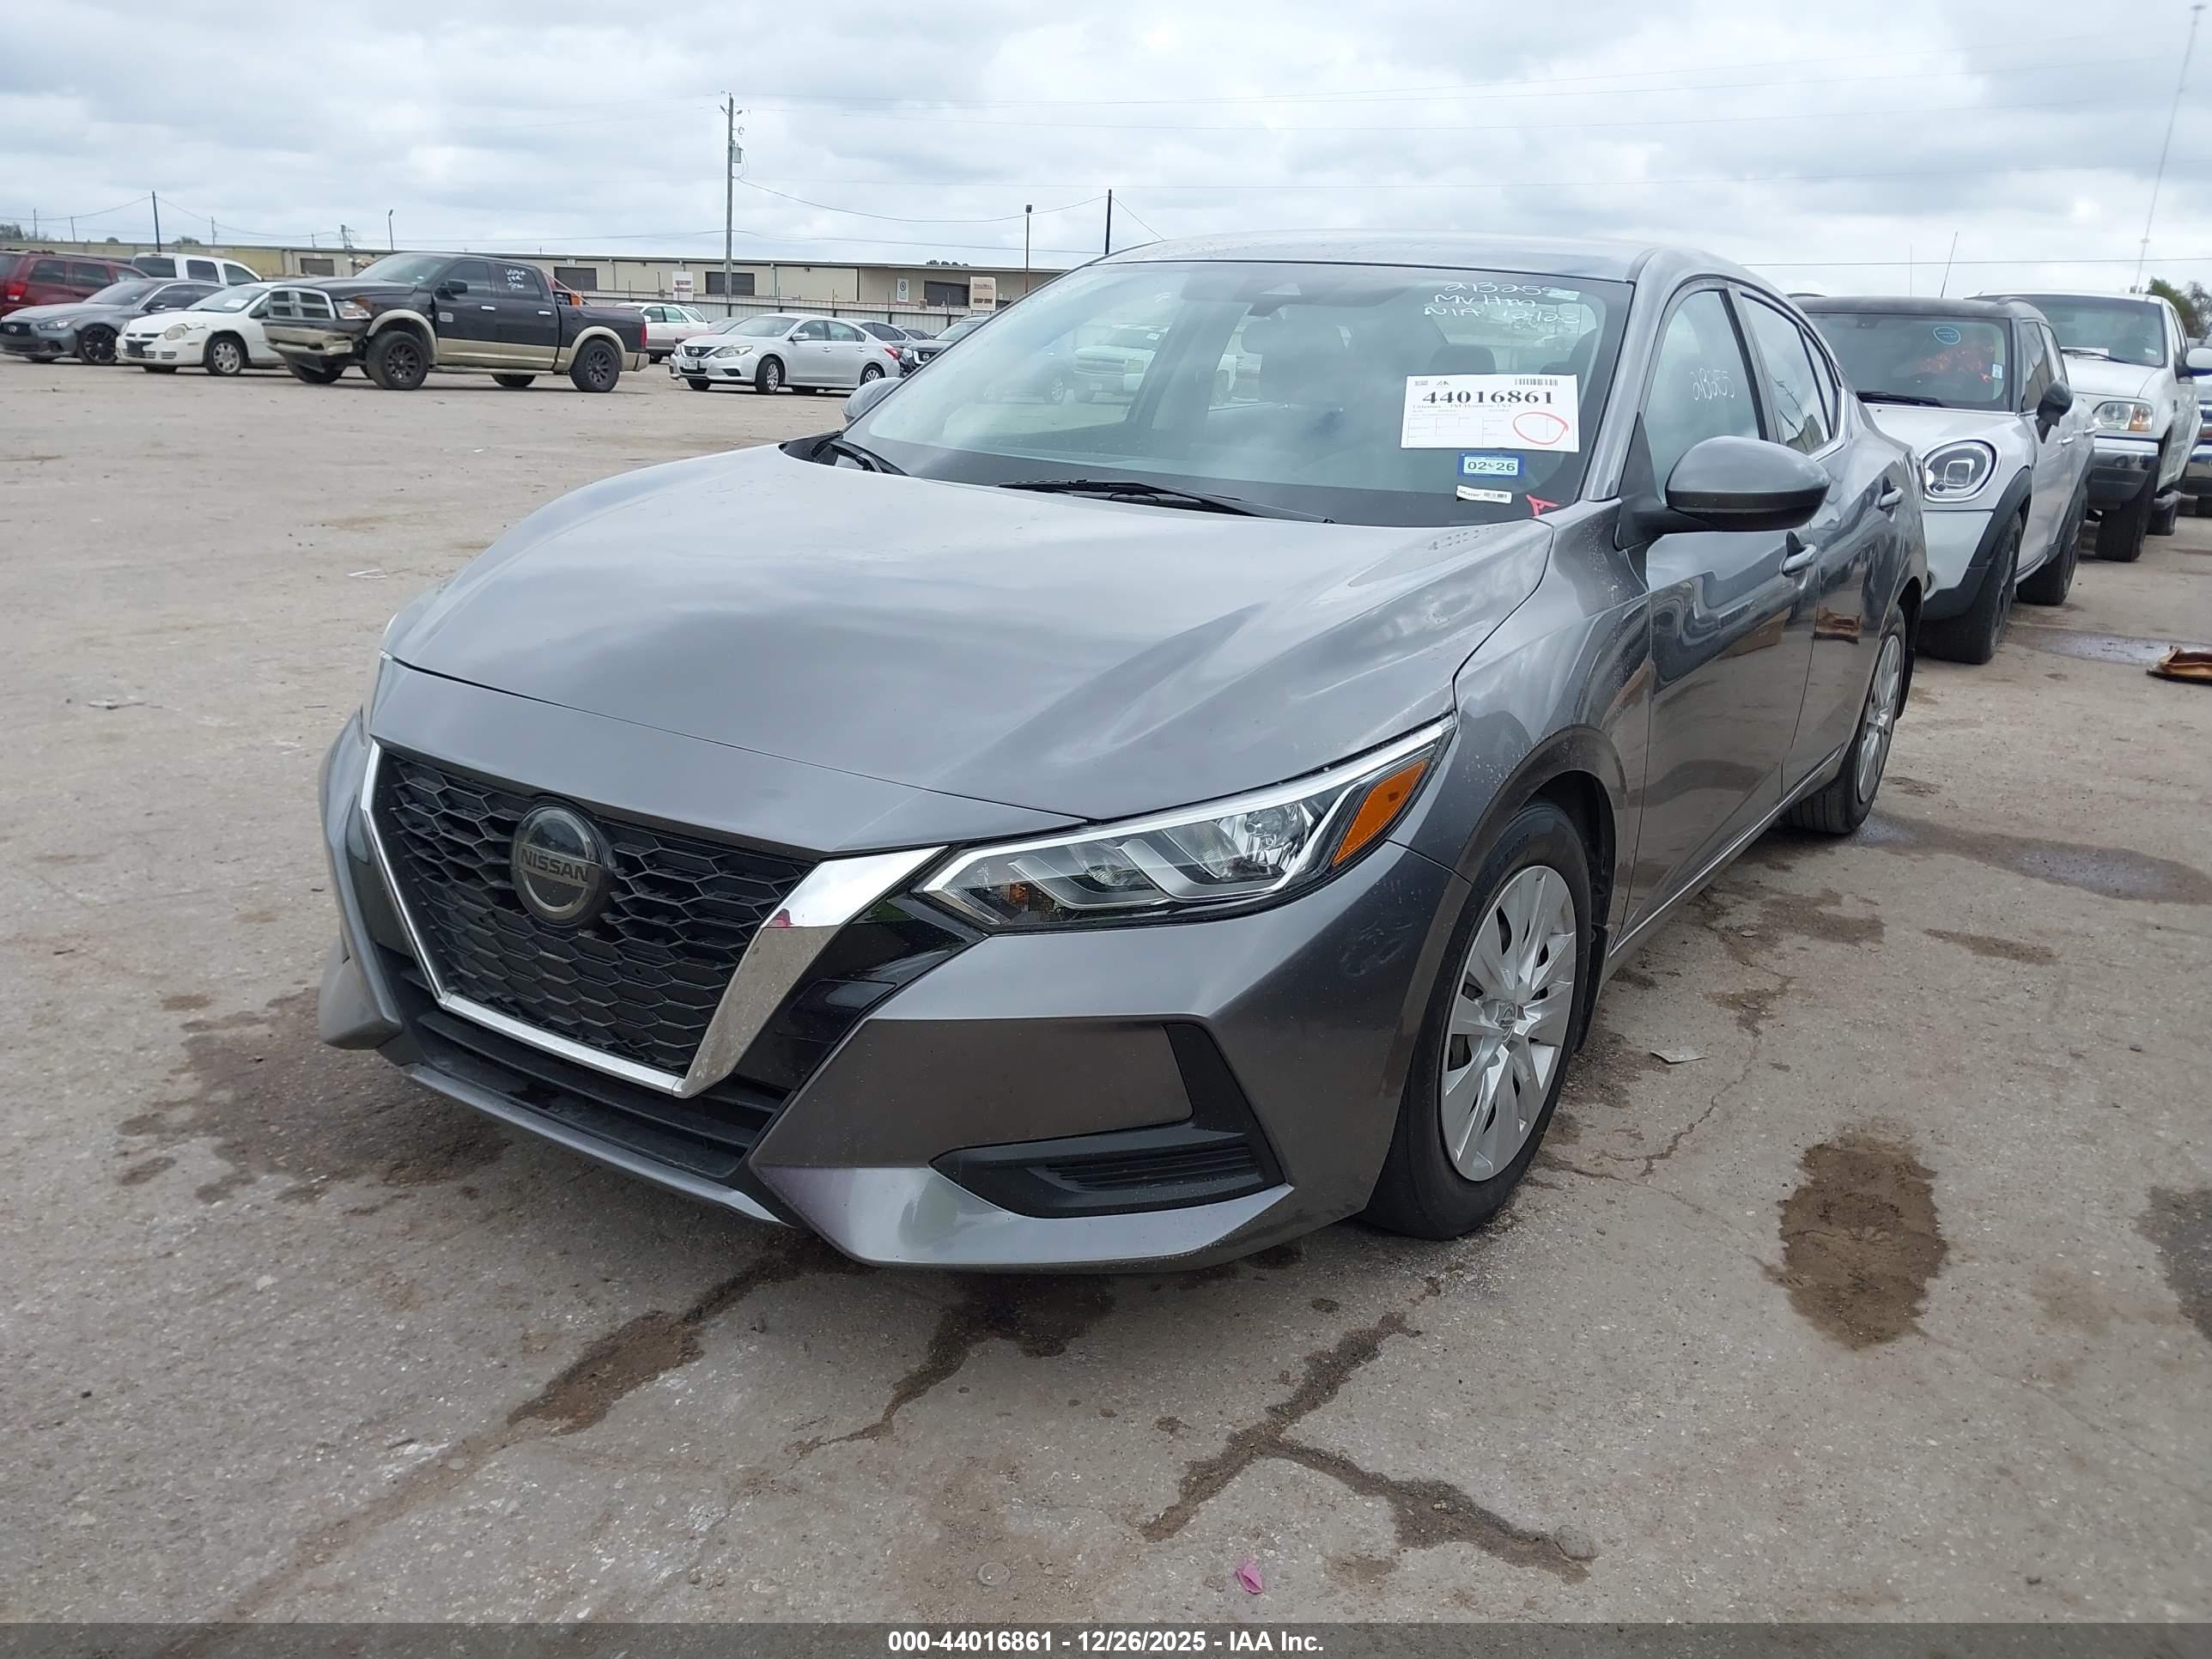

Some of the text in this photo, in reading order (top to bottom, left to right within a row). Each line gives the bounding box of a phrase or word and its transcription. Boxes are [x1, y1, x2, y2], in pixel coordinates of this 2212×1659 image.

[1422, 390, 1554, 404] 44016861
[1468, 461, 1516, 471] 02 26
[520, 848, 589, 882] NISSAN
